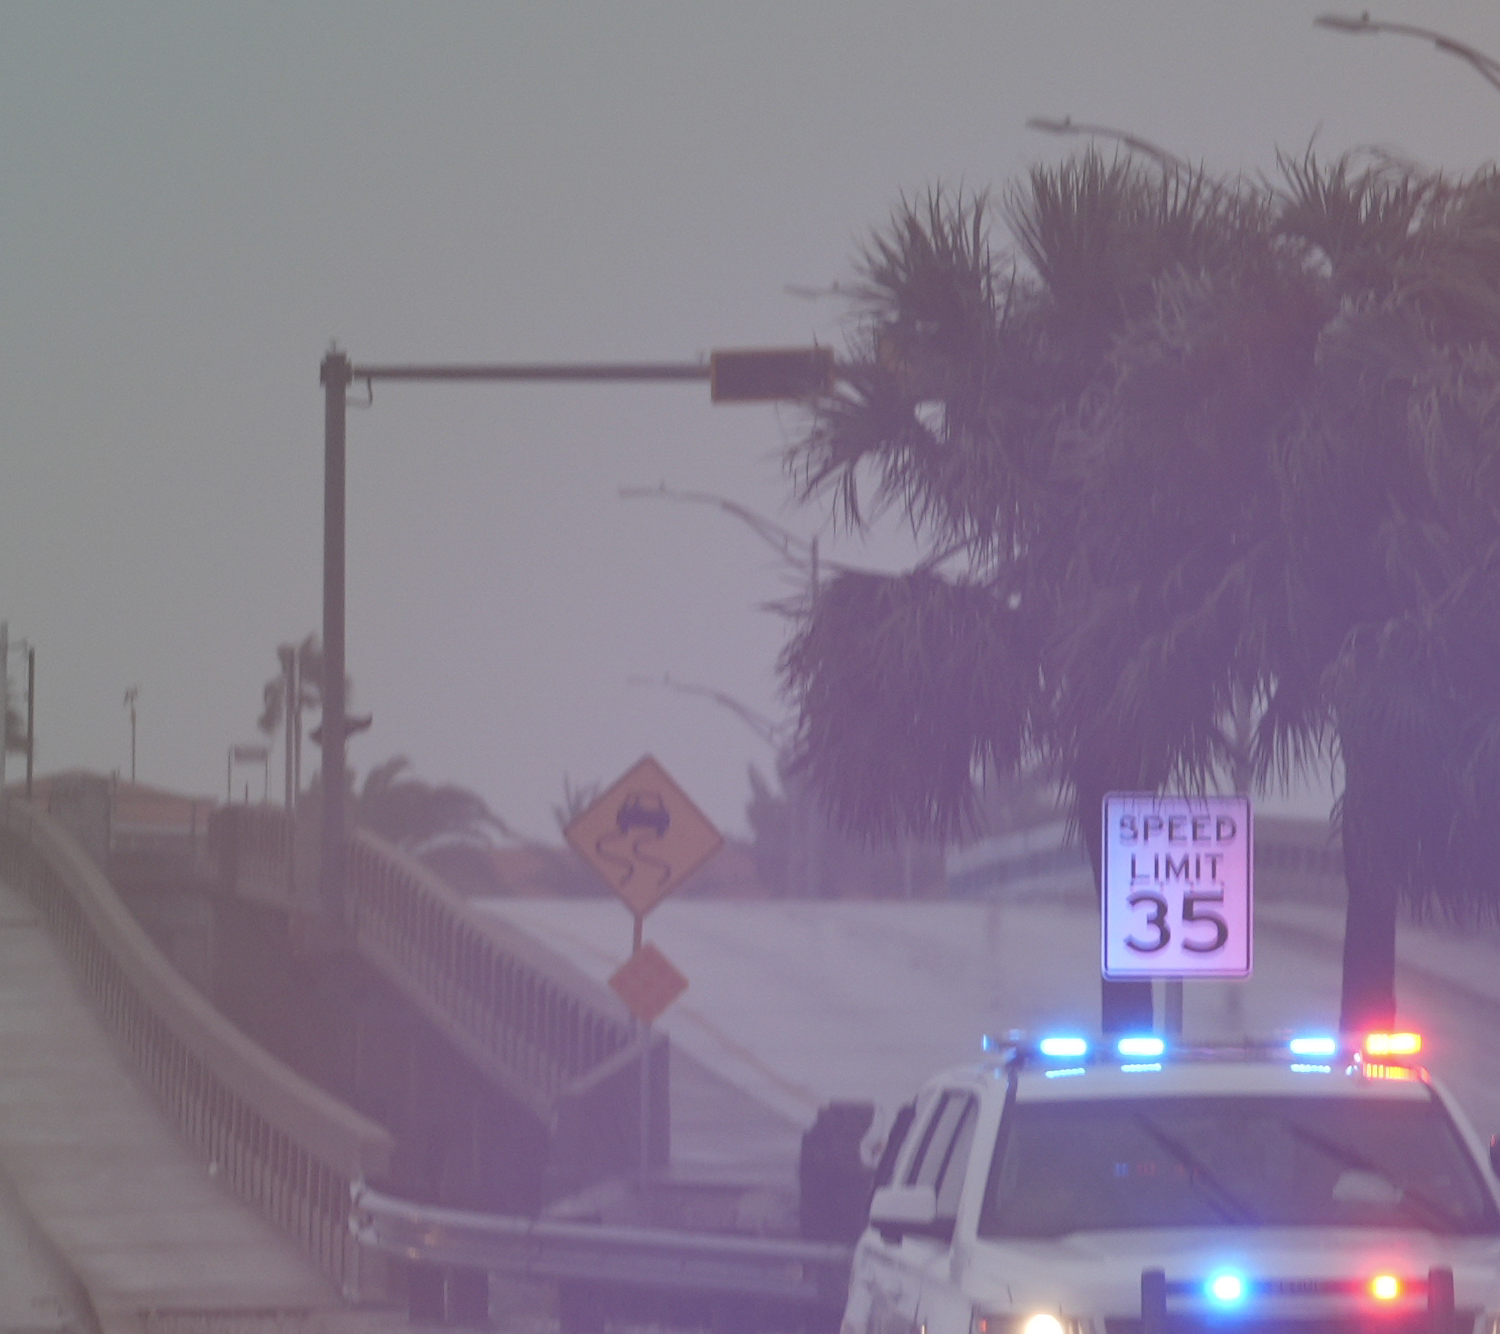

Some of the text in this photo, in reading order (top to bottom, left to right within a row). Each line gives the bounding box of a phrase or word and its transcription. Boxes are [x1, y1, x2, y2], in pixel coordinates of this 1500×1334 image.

[1118, 814, 1237, 843] SPEED
[1130, 852, 1224, 882] LIMIT
[1124, 890, 1229, 953] 35
